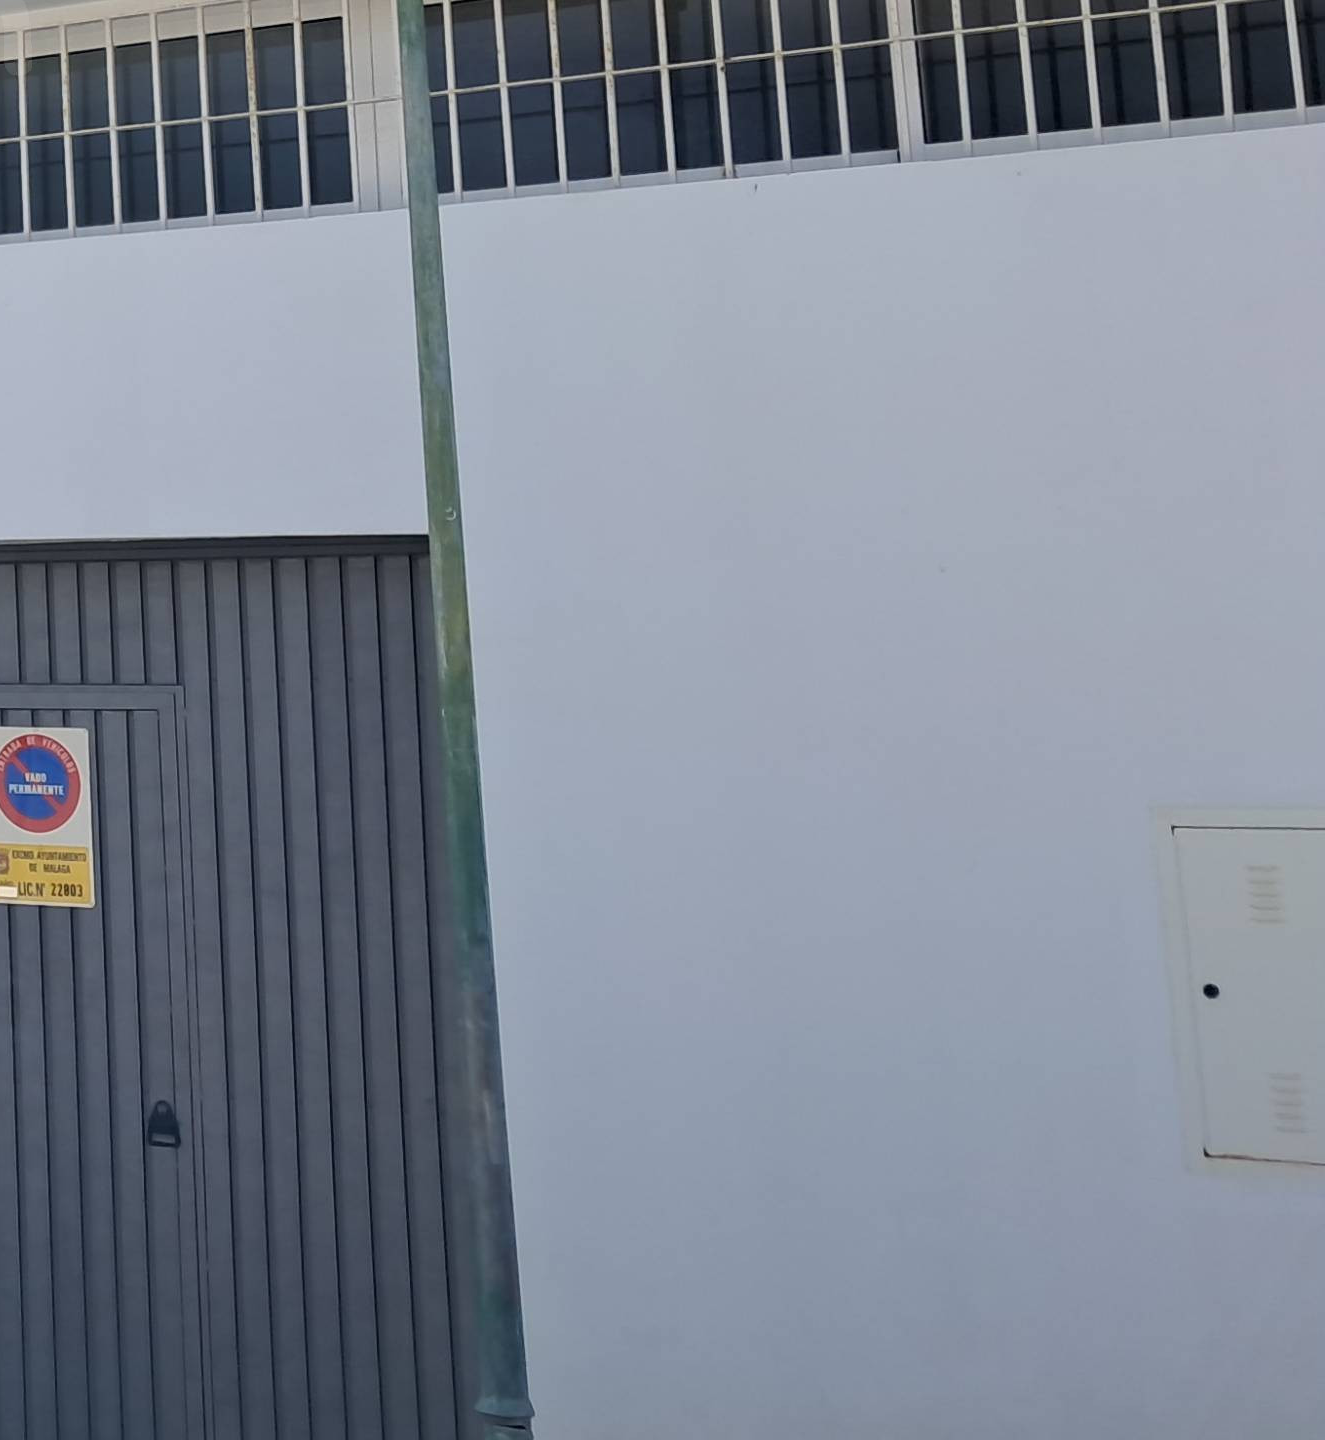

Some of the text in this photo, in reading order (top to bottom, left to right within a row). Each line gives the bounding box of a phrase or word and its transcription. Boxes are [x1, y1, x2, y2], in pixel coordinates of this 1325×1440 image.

[24, 772, 47, 783] VADO
[8, 783, 65, 796] PERMANENTE
[37, 851, 87, 862] AYUNTAMIENTO
[29, 863, 37, 872] DE
